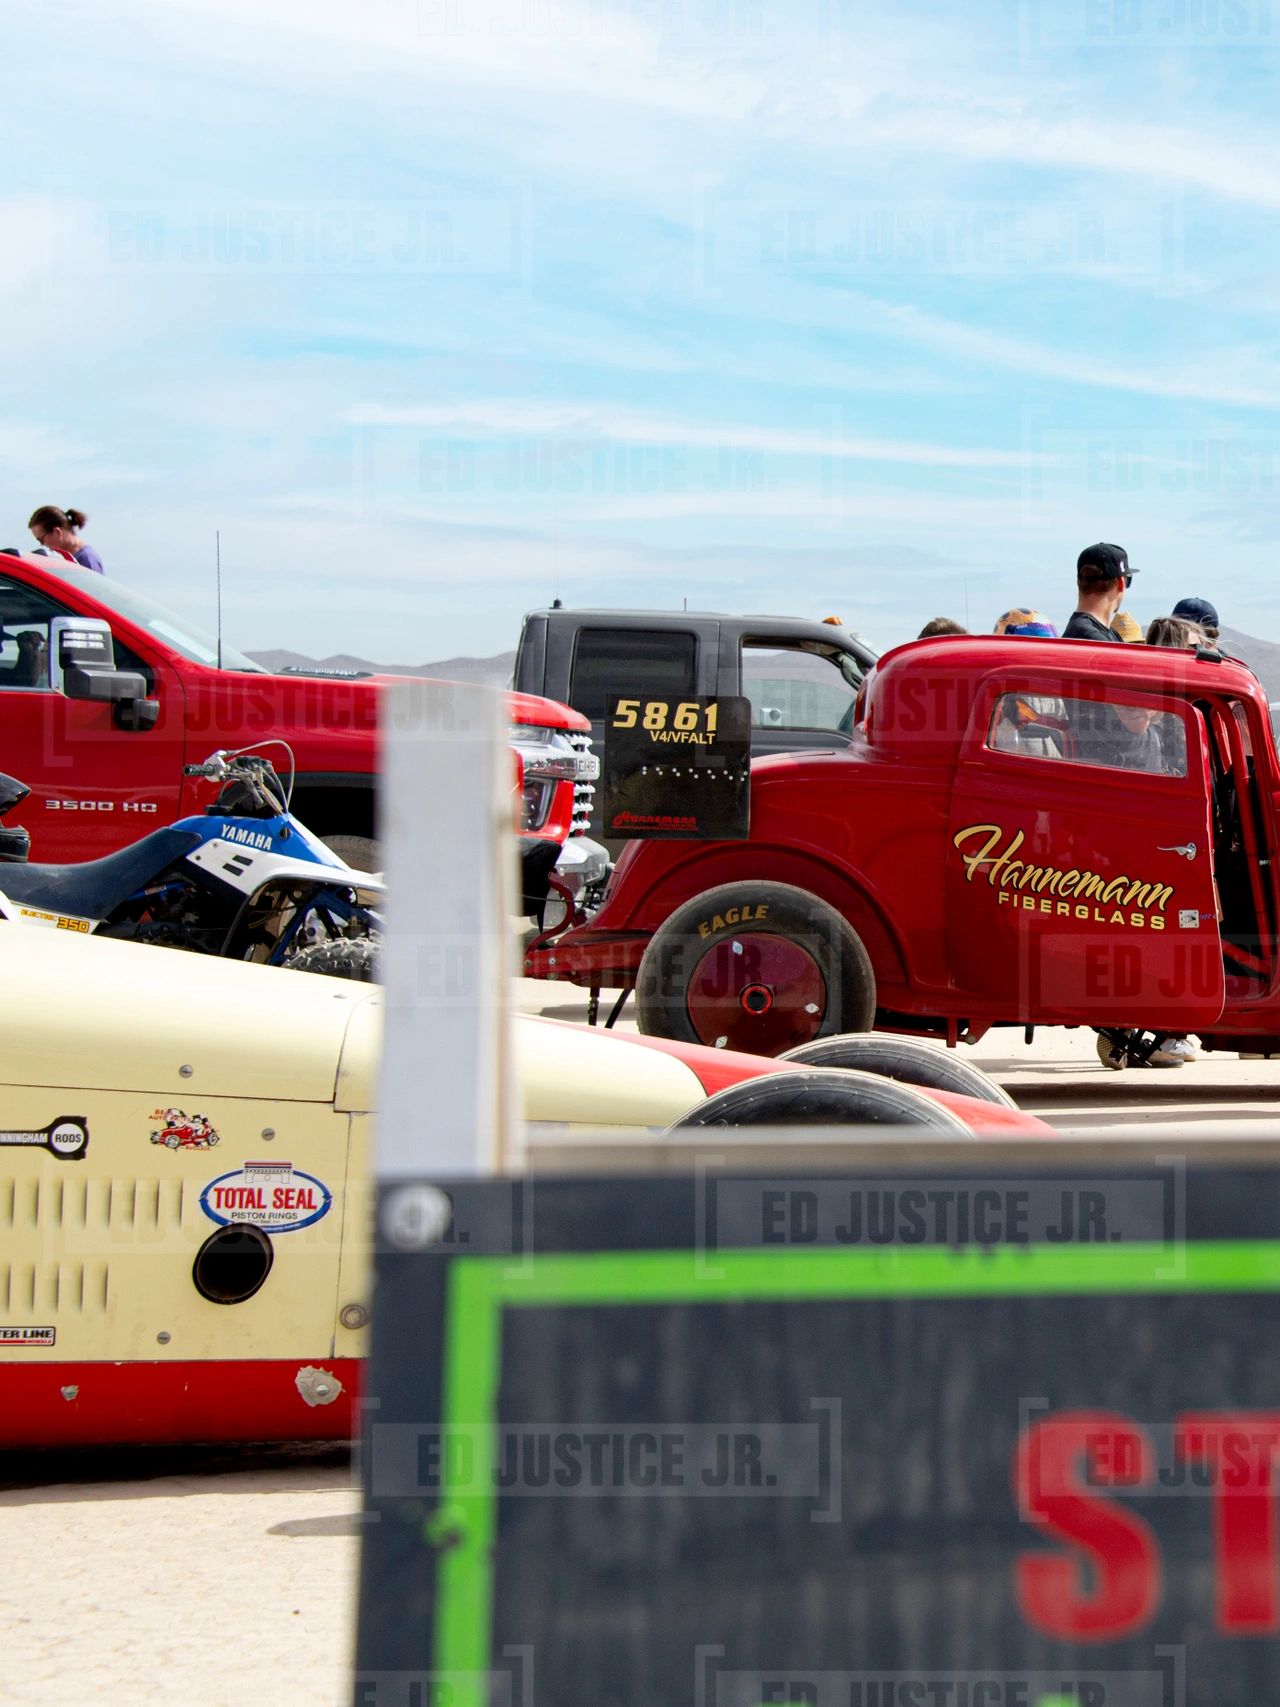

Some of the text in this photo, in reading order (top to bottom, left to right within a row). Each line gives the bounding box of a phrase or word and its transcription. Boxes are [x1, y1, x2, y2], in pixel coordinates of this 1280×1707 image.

[613, 699, 718, 732] 5861
[650, 731, 716, 745] V4/VFALT
[46, 800, 157, 813] 3500 HD
[221, 824, 273, 850] YAMAHA
[953, 824, 1175, 911] Hannemann
[998, 891, 1166, 930] FIBERGLASS
[57, 916, 91, 934] 350
[698, 905, 770, 940] EAGLE
[55, 1133, 82, 1143] RODS
[214, 1187, 318, 1210] TOTAL SEAL
[231, 1211, 298, 1220] PISTON RINGS
[23, 1330, 52, 1338] LINE
